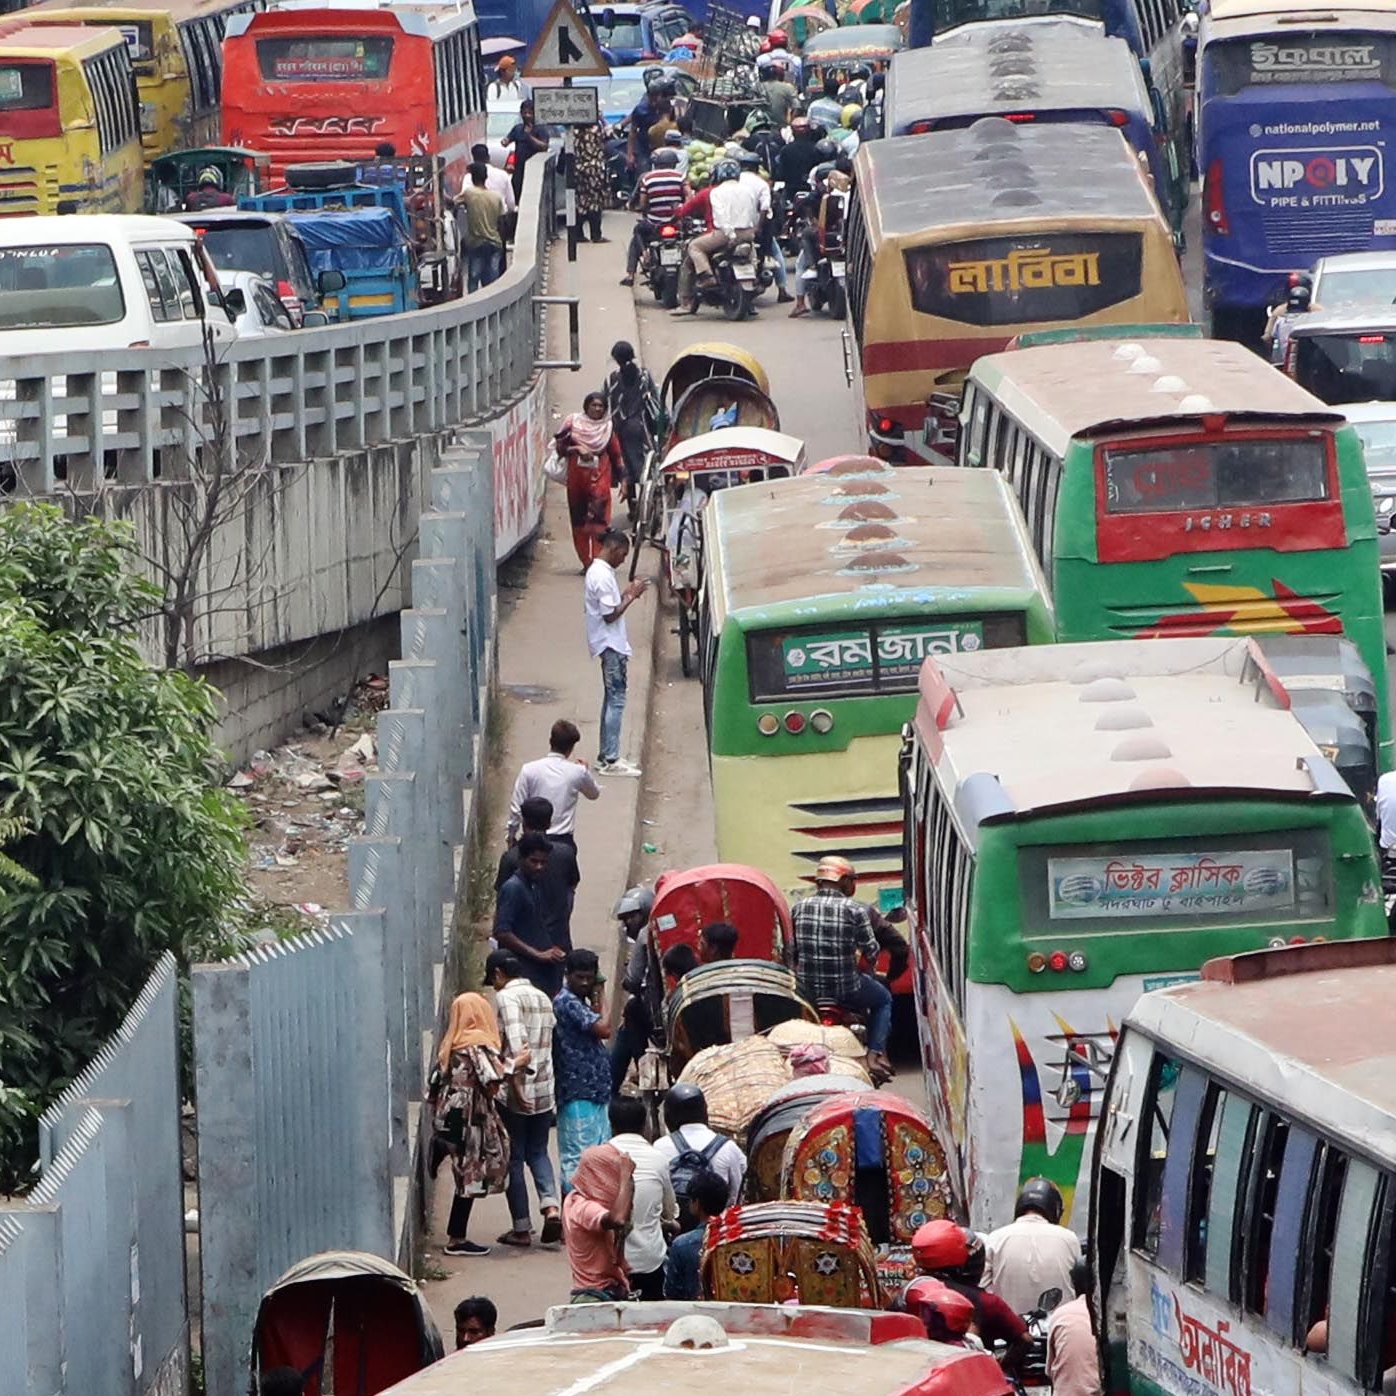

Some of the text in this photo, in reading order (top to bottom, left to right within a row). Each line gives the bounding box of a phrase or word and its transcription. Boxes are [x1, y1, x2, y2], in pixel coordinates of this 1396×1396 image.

[1264, 120, 1380, 136] nationalpolymer.net
[1271, 197, 1297, 208] PIPE
[948, 248, 1101, 293] লাবিবা
[806, 631, 960, 668] রমজান
[1105, 857, 1244, 893] ভিক্টর ক্লাসিক
